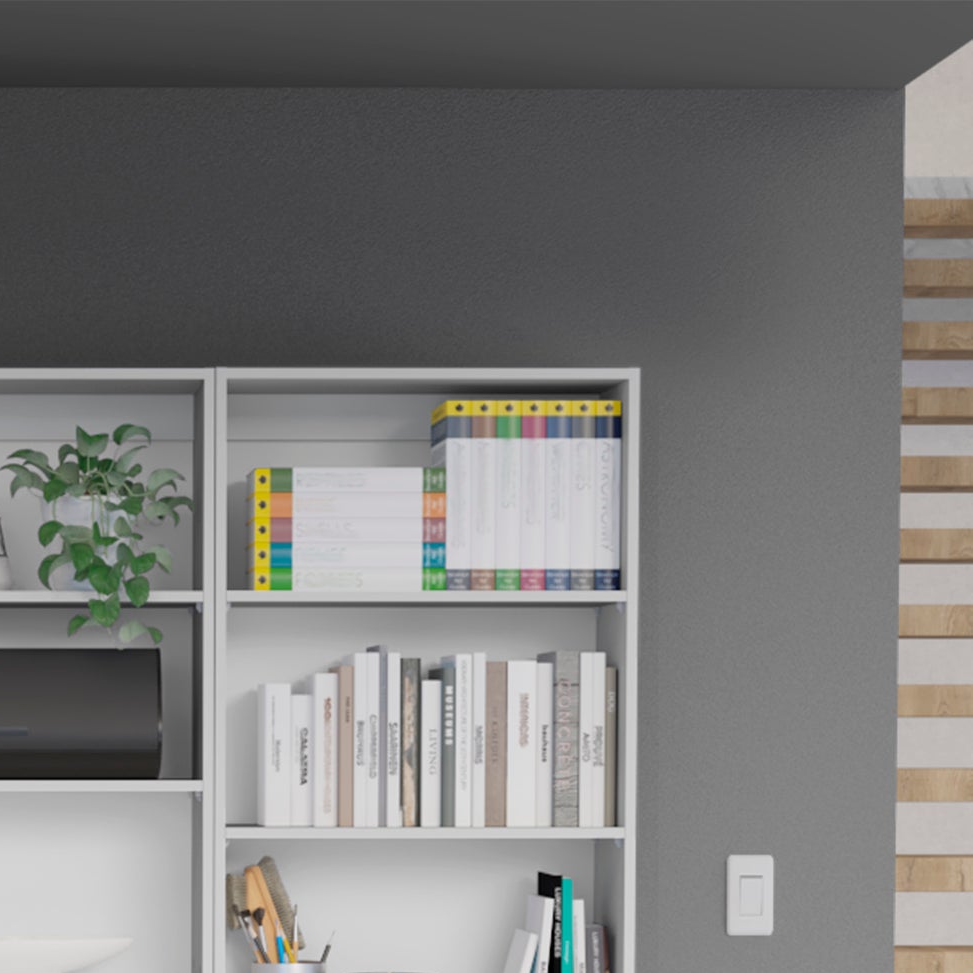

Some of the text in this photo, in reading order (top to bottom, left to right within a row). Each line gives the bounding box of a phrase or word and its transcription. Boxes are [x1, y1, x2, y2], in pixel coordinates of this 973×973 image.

[428, 728, 437, 777] LIVING
[556, 678, 572, 791] CONCRETE
[554, 887, 562, 959] LUXURY HOUSES
